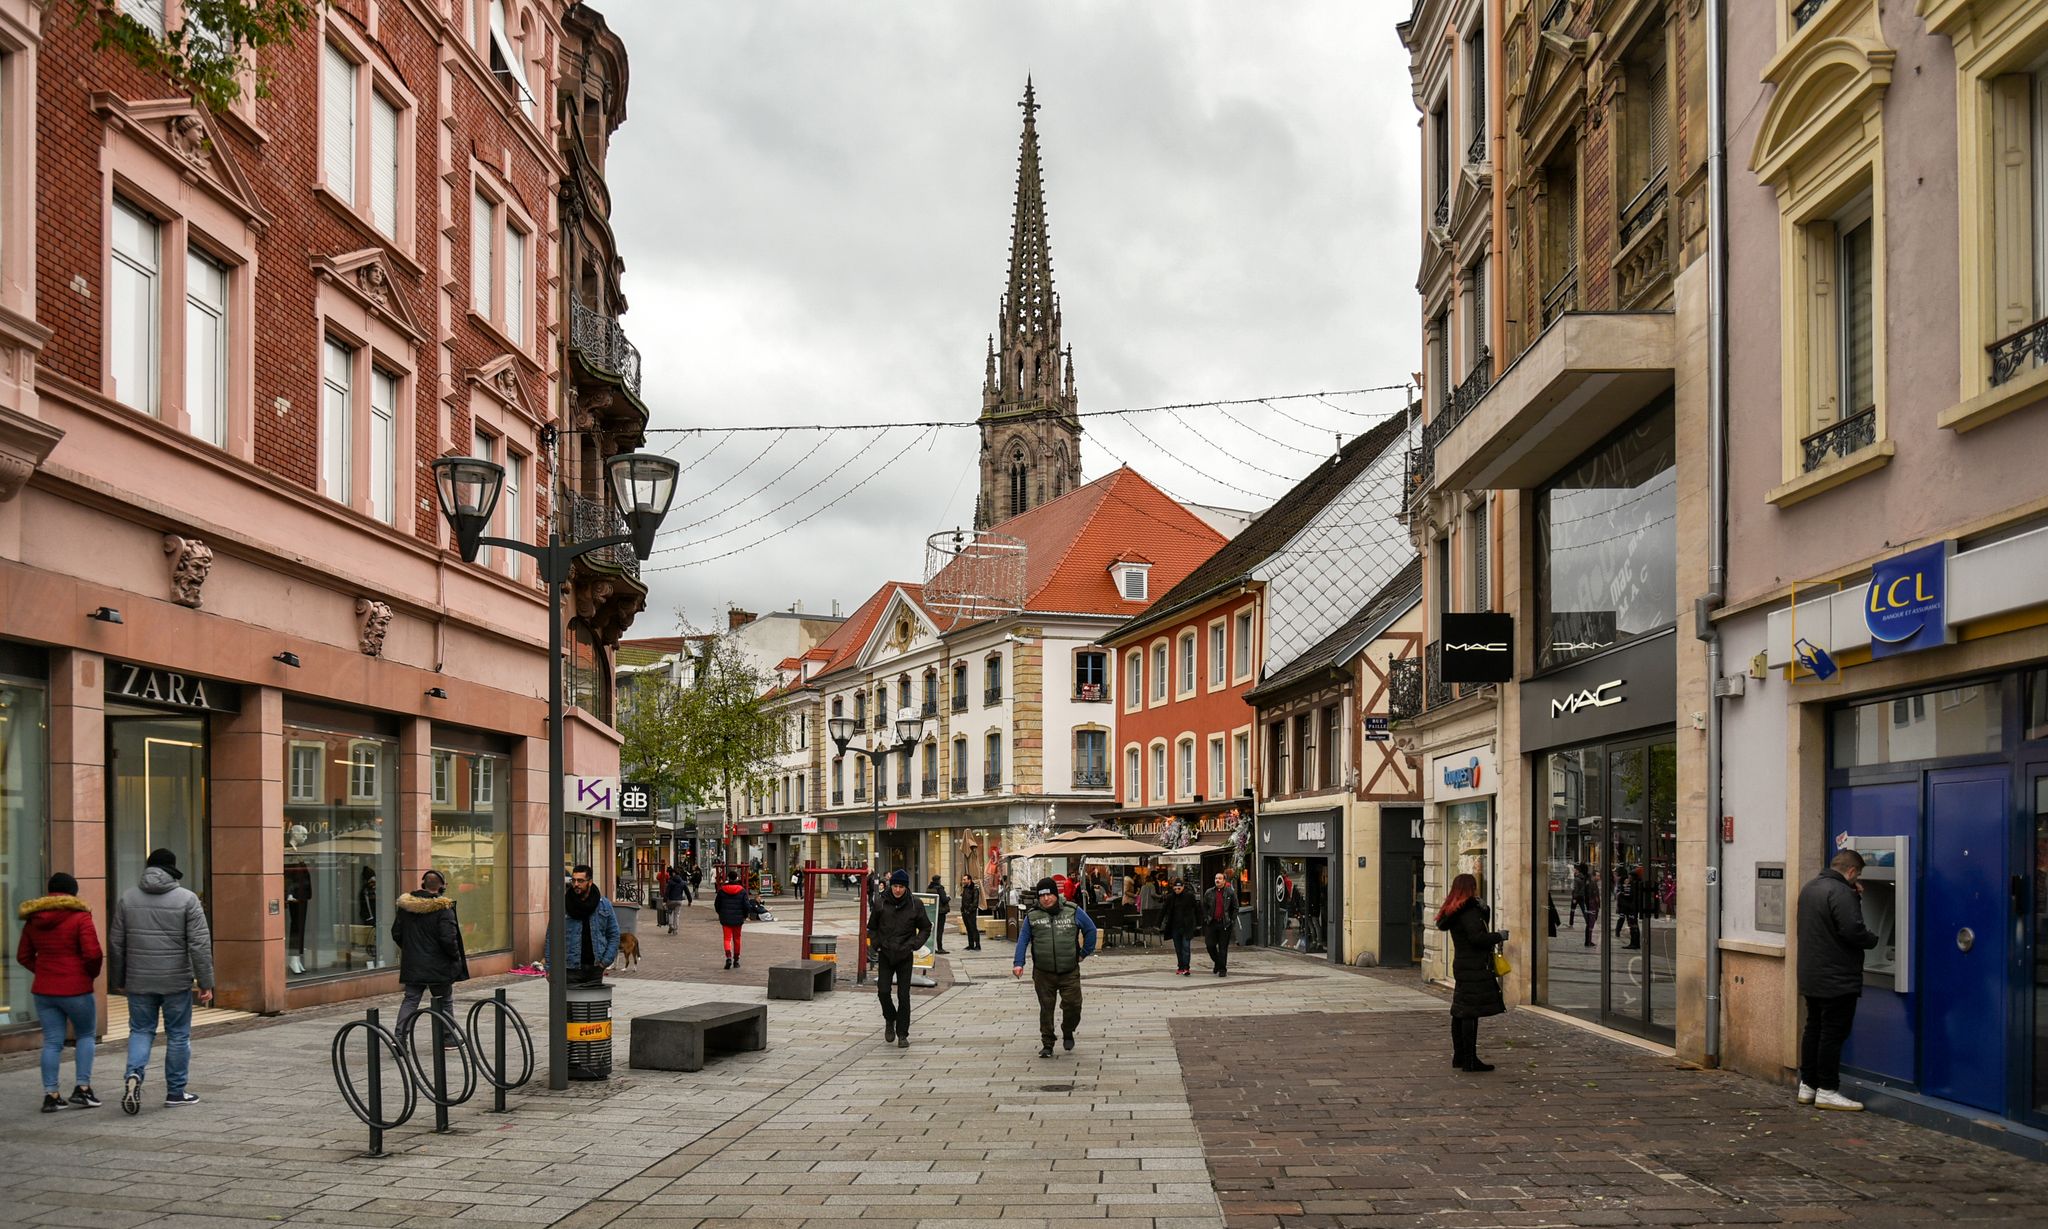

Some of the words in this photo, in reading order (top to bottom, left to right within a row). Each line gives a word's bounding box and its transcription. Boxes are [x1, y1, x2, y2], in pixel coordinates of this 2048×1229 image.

[1870, 572, 1934, 613] LCL
[1882, 611, 1904, 621] BANQUE
[1911, 602, 1941, 614] ASSURANCE
[121, 664, 210, 708] ZARA
[1411, 819, 1424, 838] K
